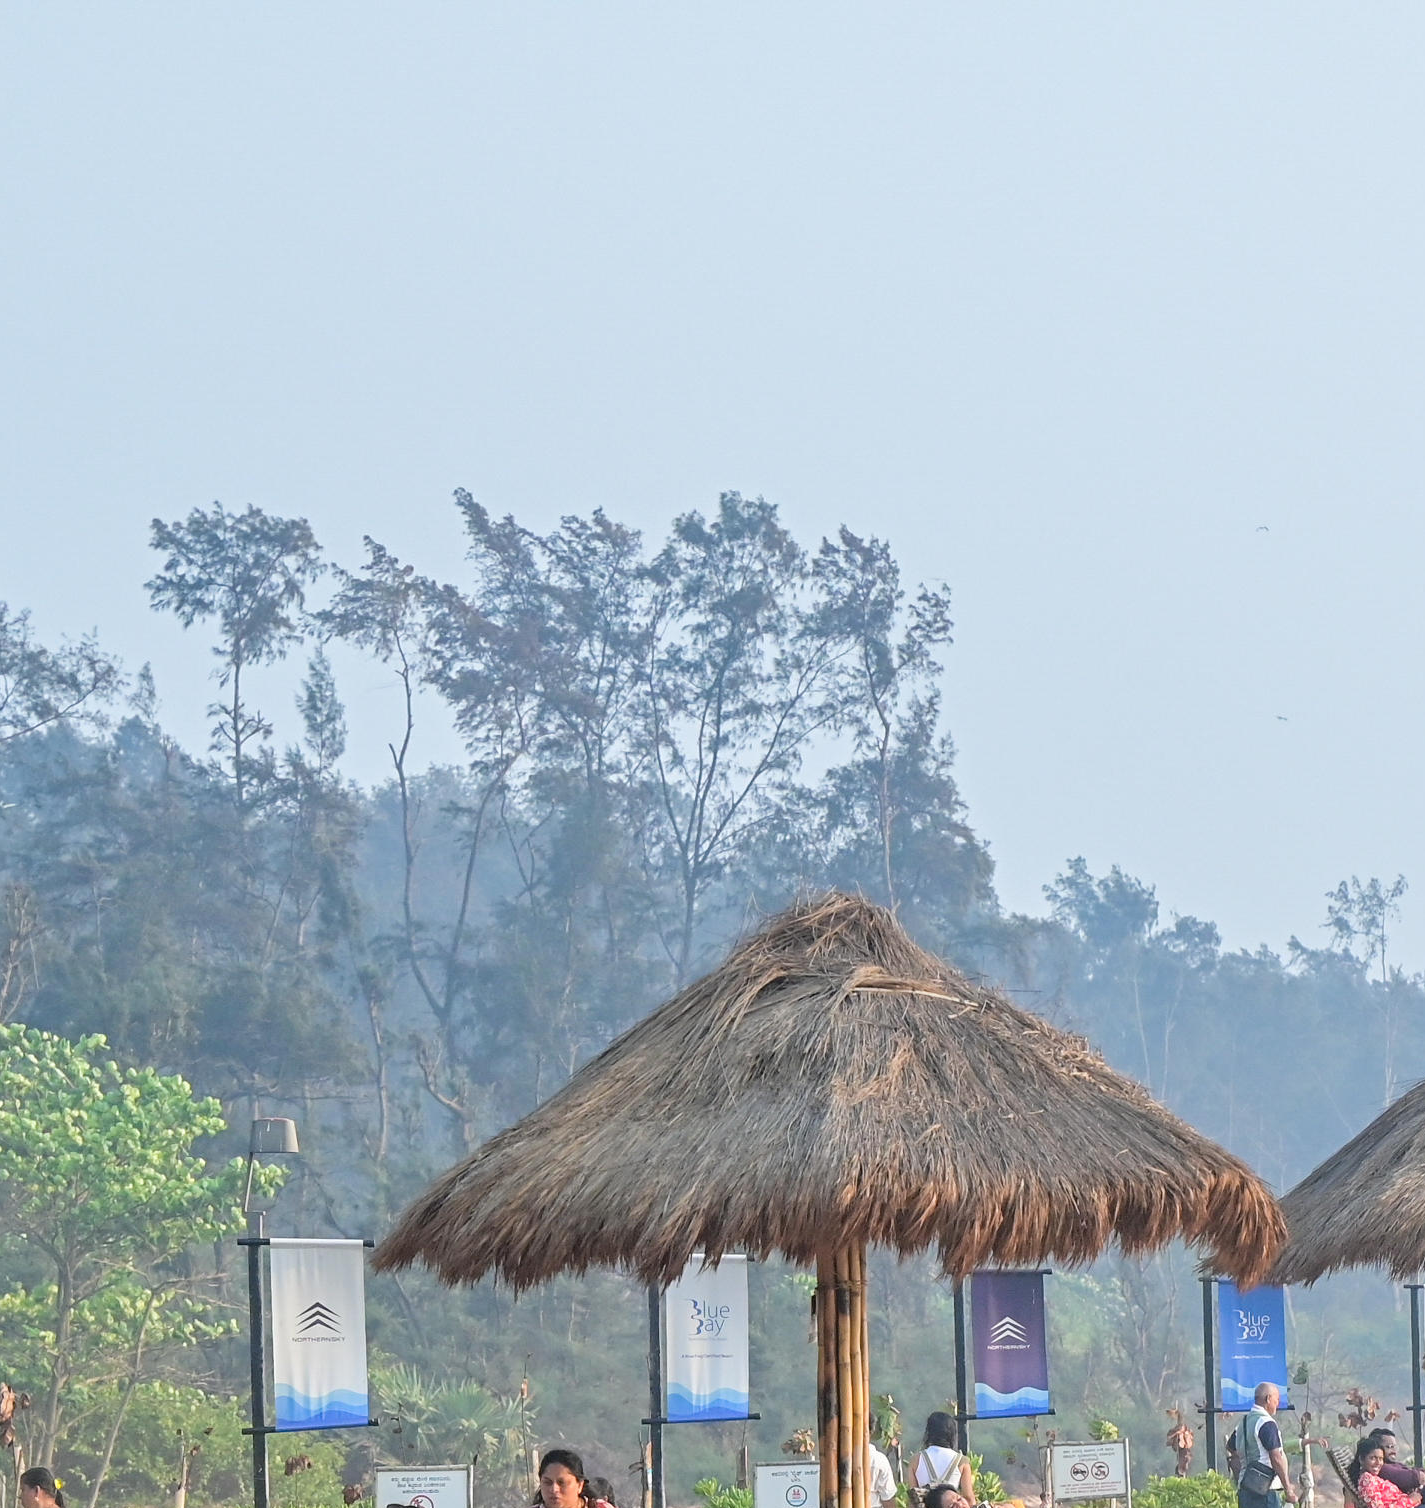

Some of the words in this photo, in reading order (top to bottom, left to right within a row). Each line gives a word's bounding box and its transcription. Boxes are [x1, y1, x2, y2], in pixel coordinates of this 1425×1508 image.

[684, 1299, 730, 1319] Blue
[1233, 1310, 1270, 1326] Blue
[688, 1318, 725, 1337] Bay
[1236, 1325, 1266, 1341] Bay
